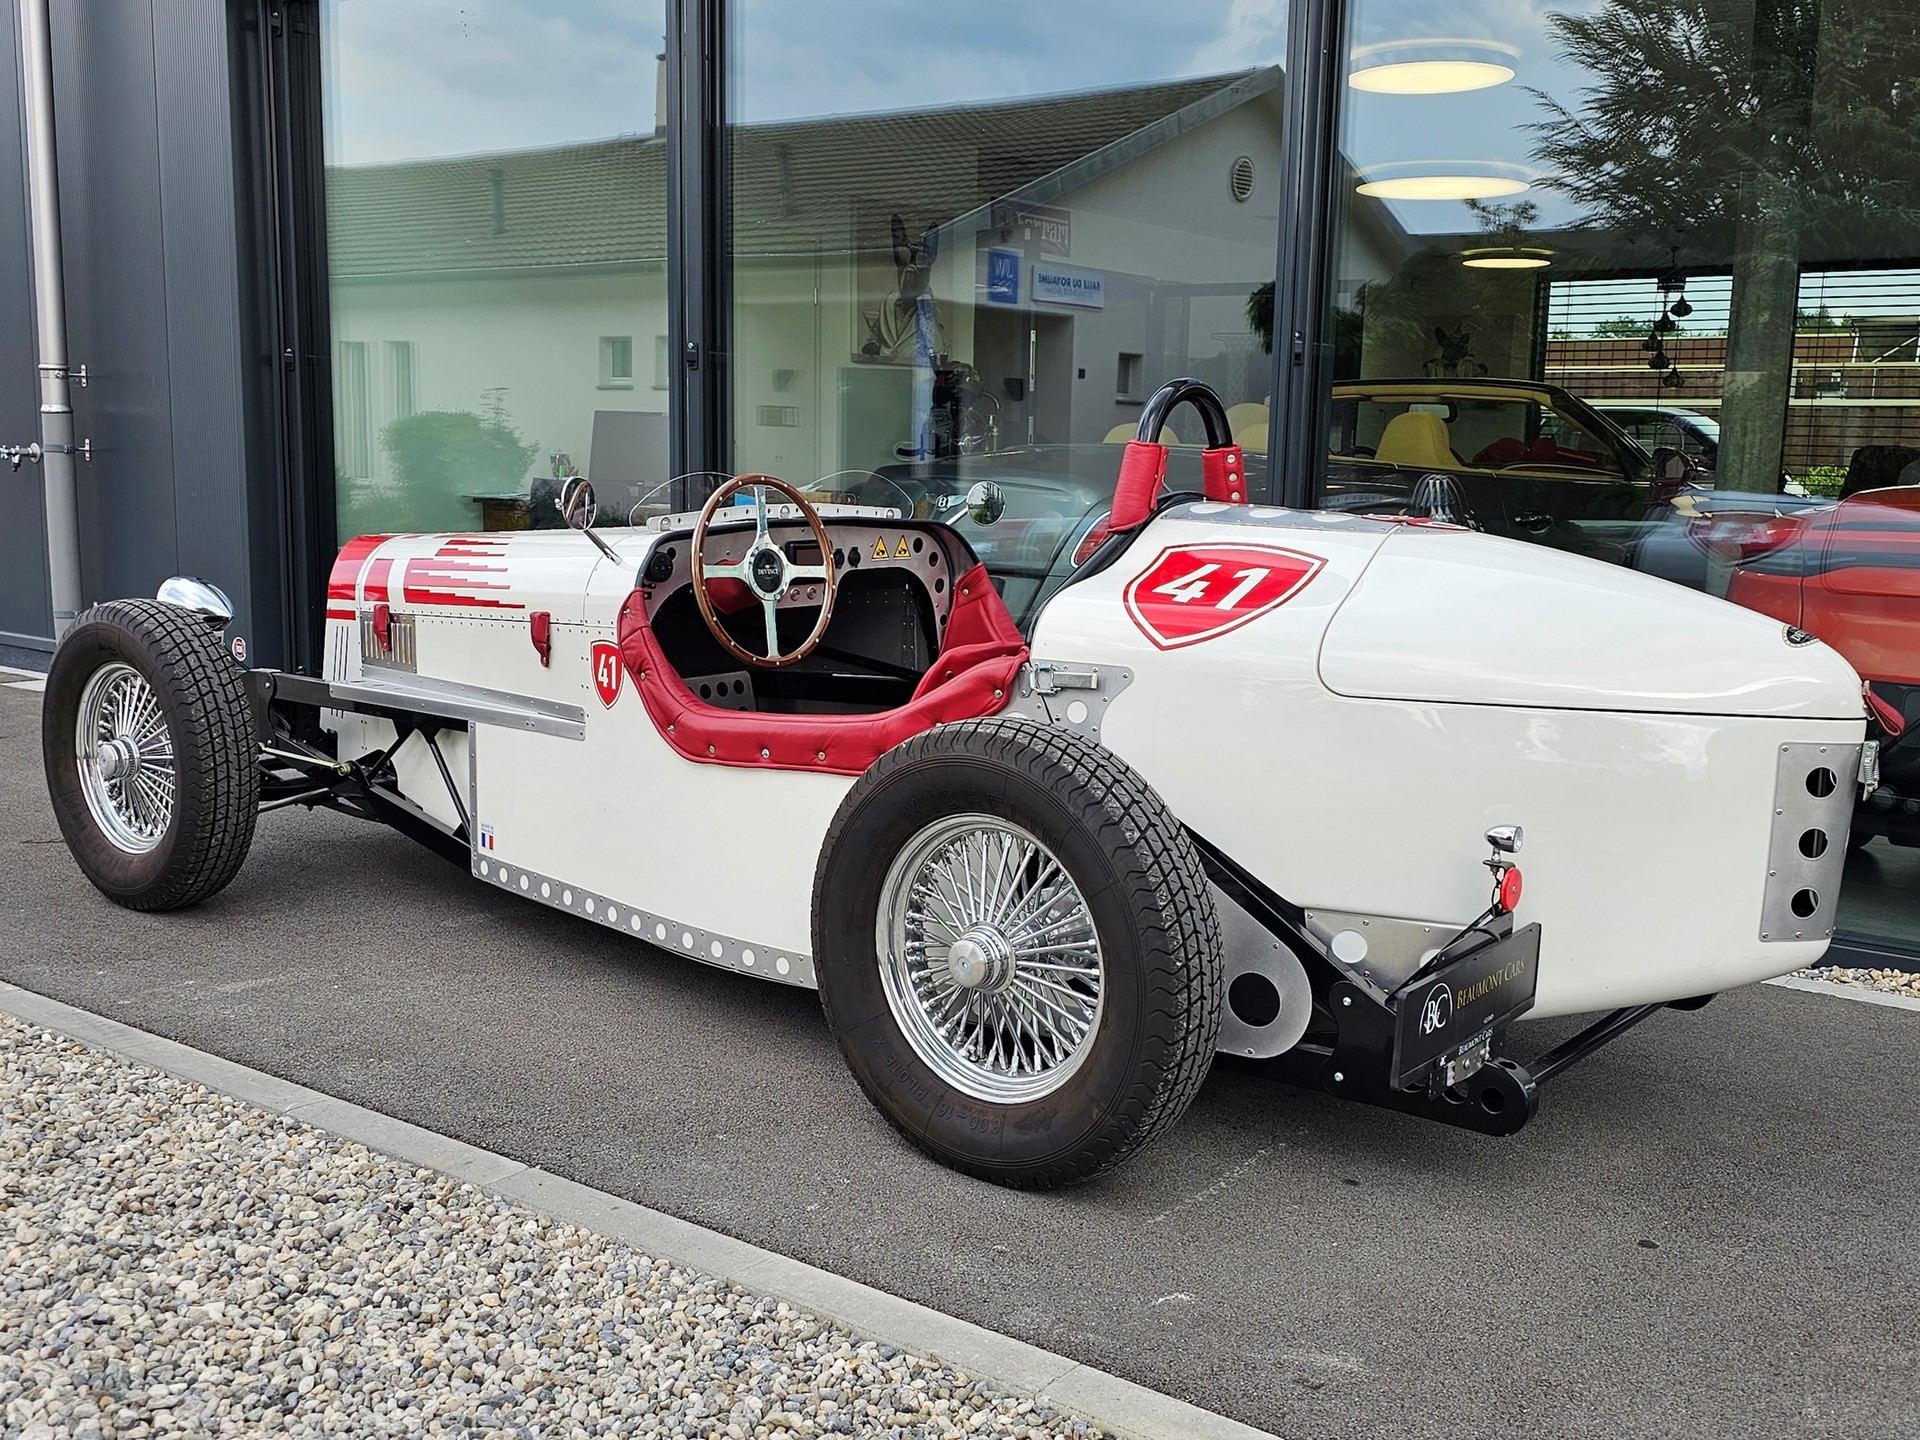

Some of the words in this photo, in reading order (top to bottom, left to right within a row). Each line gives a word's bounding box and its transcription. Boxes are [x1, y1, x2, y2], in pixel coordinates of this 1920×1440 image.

[1152, 563, 1272, 611] 41
[597, 653, 617, 690] 41
[1456, 968, 1504, 1010] BEAUMONT
